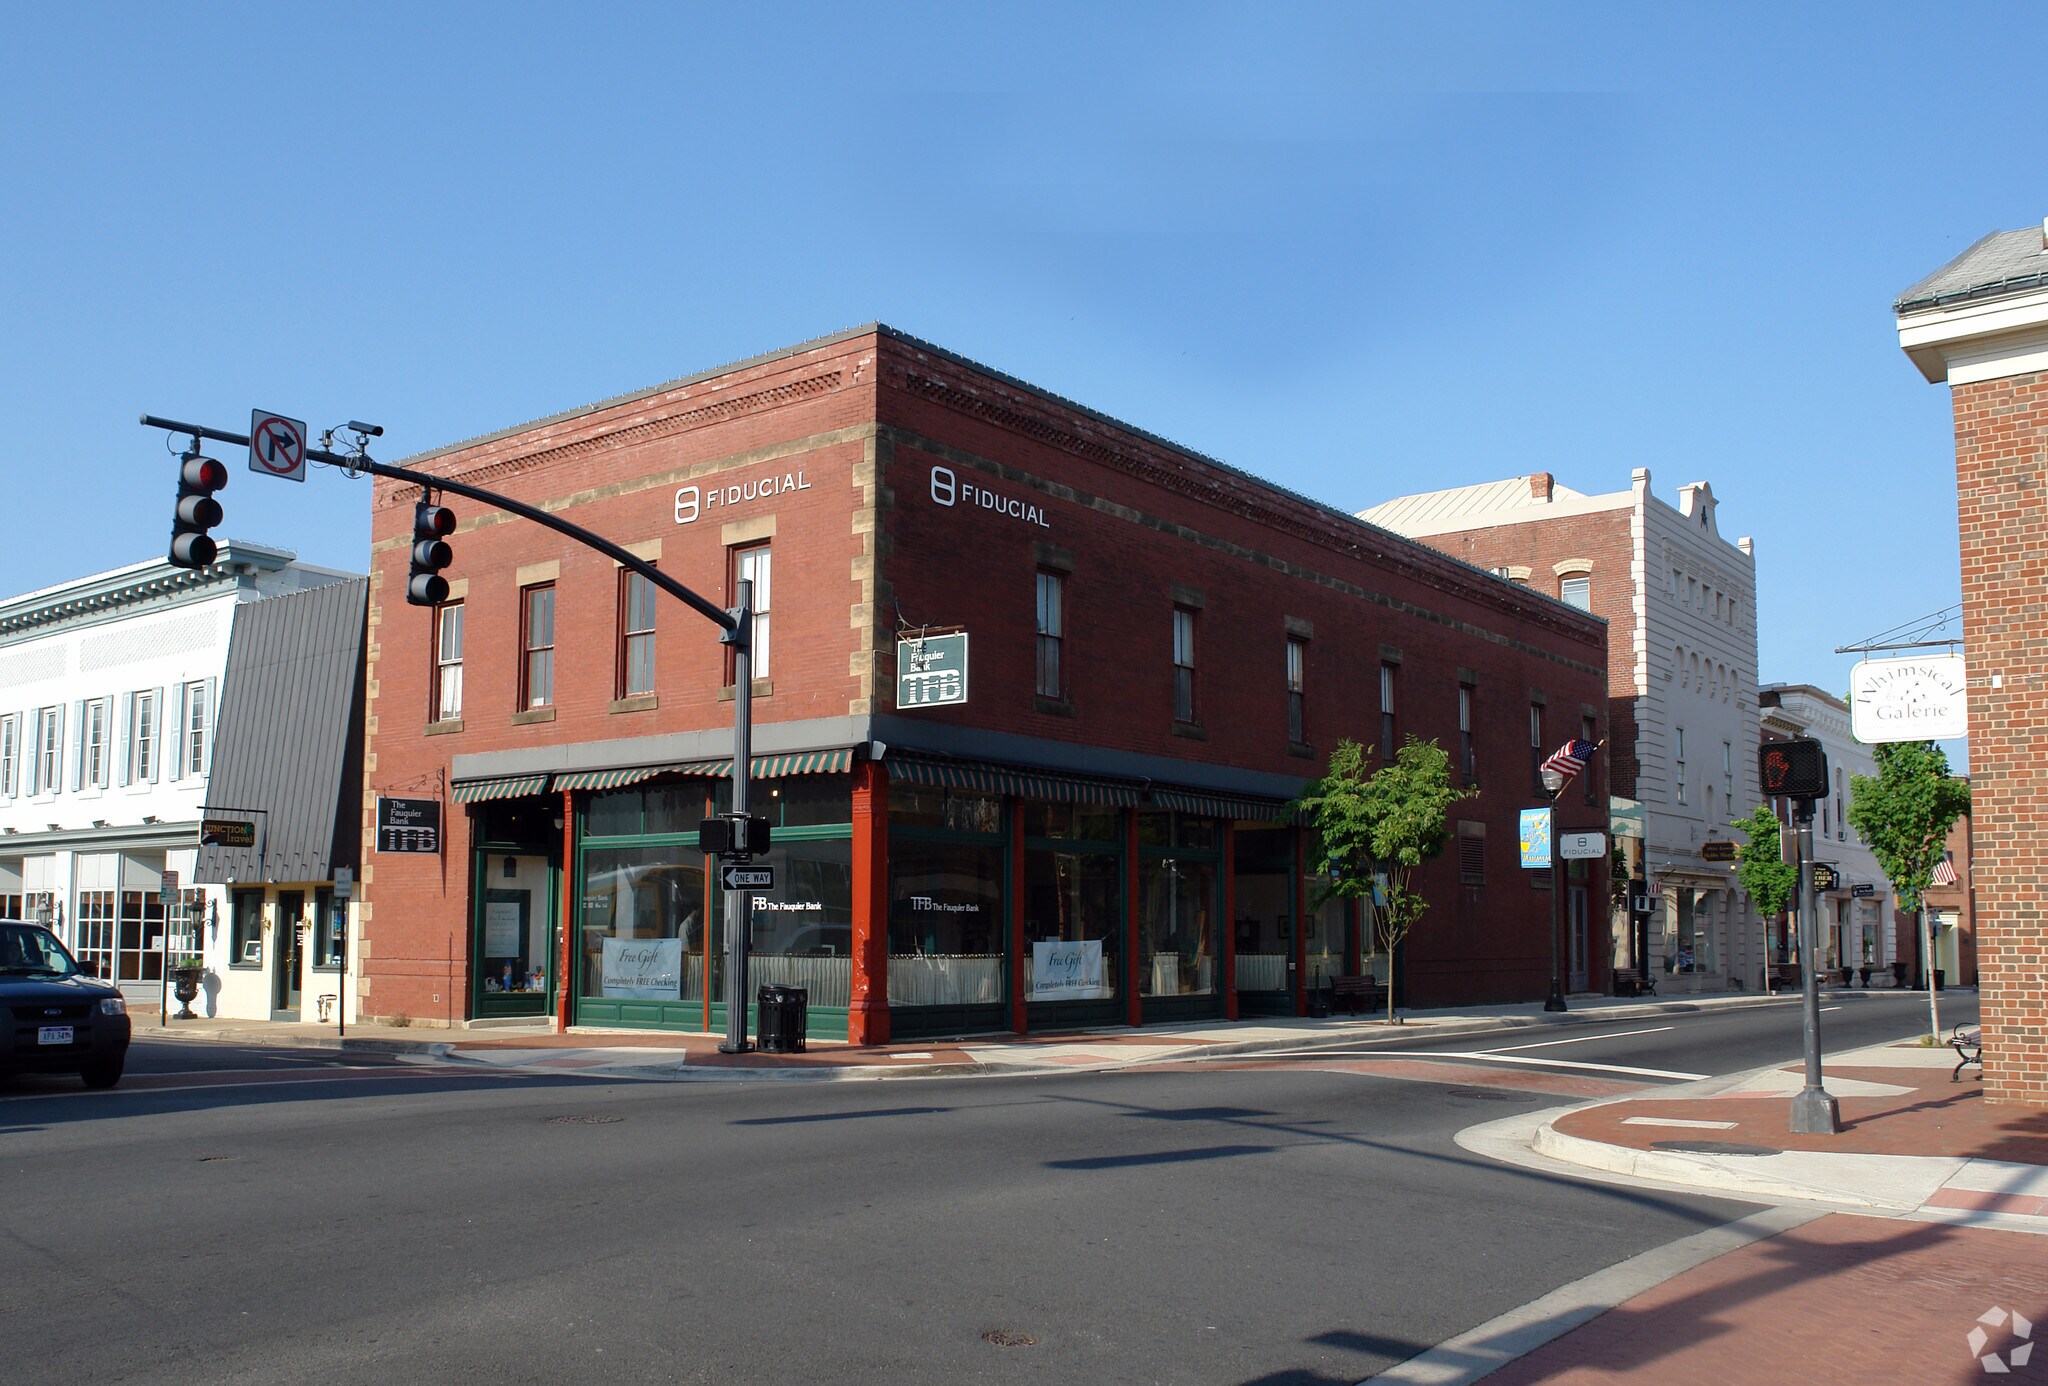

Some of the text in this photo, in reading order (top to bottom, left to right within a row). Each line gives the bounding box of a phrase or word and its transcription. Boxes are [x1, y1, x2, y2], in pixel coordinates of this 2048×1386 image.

[706, 472, 812, 509] FIDUCIAL
[962, 484, 1050, 528] FIDUCIAL
[902, 669, 961, 704] TFB
[1857, 665, 1965, 703] Whimsical
[1876, 703, 1948, 720] Galerie
[391, 809, 421, 818] Fauquier
[392, 801, 406, 809] The
[203, 825, 247, 834] JUNCTION
[390, 817, 409, 825] Bank
[226, 826, 252, 843] Travel
[382, 825, 437, 851] TFB
[735, 873, 769, 883] ONE WAY
[753, 896, 767, 910] FB
[780, 902, 805, 912] Fauquier
[806, 902, 822, 910] Bank
[910, 896, 932, 910] TFB
[932, 903, 943, 911] The
[943, 903, 966, 913] Fauquier
[619, 941, 664, 976] Free Gift
[1049, 944, 1087, 979] Free Gift
[603, 976, 678, 988] Completely FREE Checking
[1036, 980, 1064, 990] Completely
